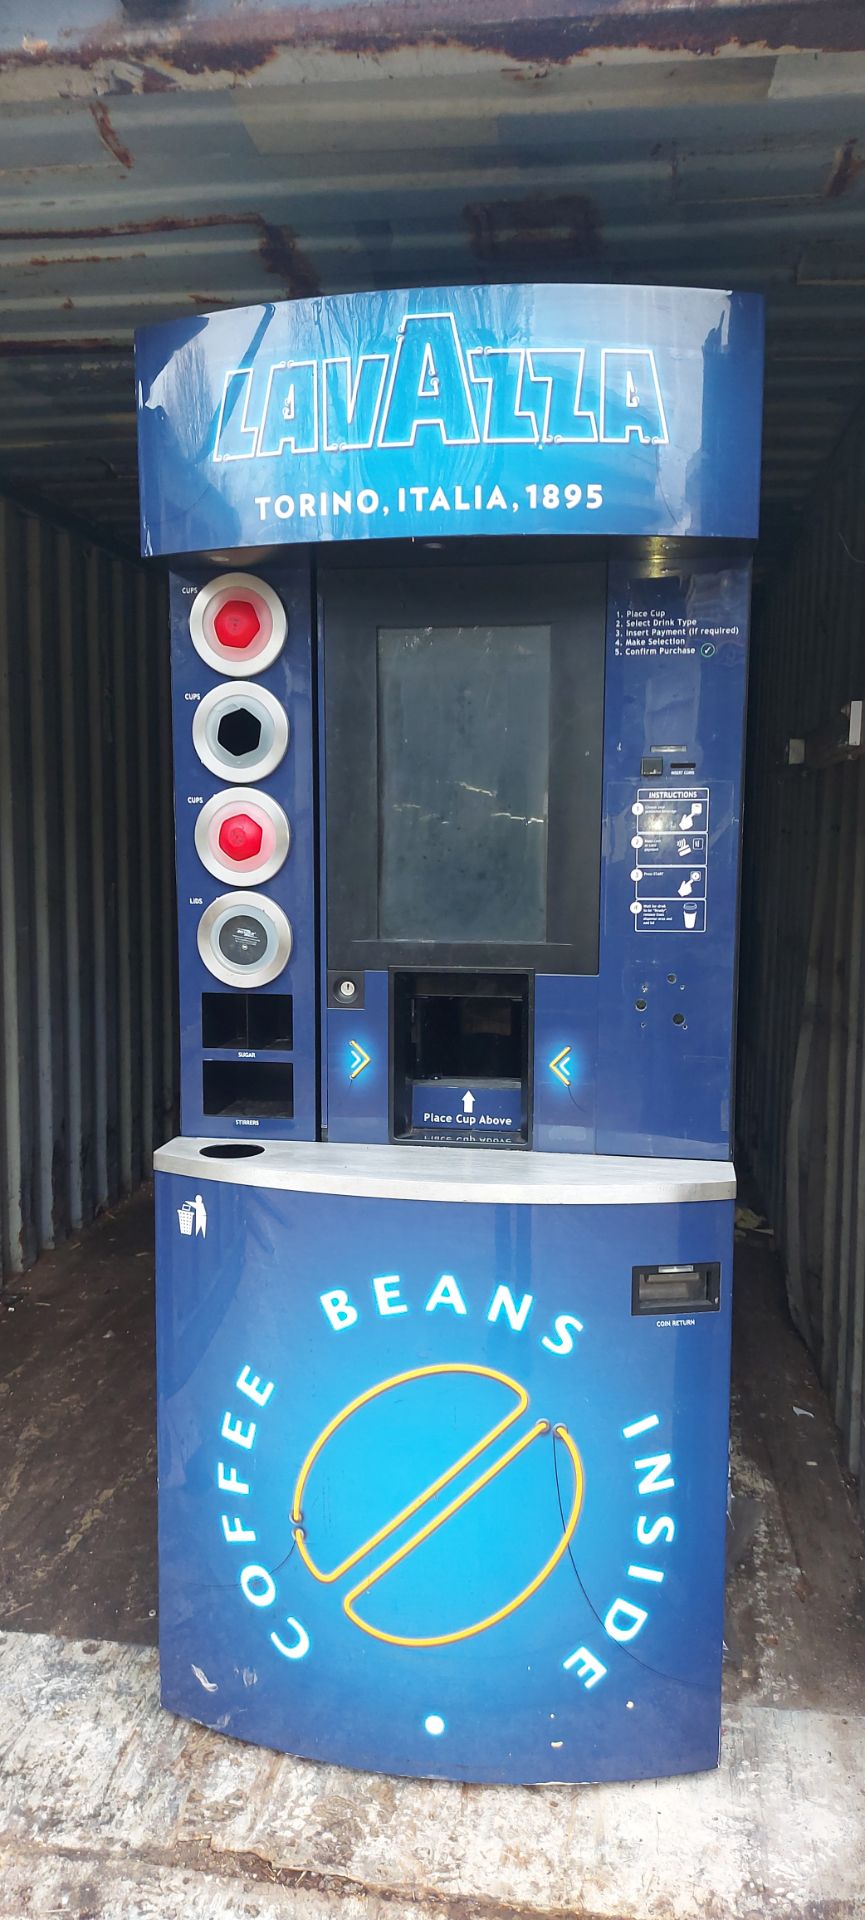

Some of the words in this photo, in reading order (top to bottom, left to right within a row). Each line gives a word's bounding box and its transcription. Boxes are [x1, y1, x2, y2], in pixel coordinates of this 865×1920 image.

[212, 312, 670, 463] LAVAZZA
[255, 488, 389, 521] TORINO,
[398, 486, 520, 514] ITALIA,
[526, 484, 603, 510] 1895
[181, 586, 198, 594] CUPS
[650, 609, 666, 619] Cup
[615, 620, 623, 628] 2.
[625, 619, 651, 627] Select
[677, 618, 697, 627] Type
[615, 629, 623, 637] 3.
[625, 629, 649, 637] Insert
[651, 628, 686, 637] Payment
[700, 626, 739, 636] required)
[625, 638, 646, 646] Make
[648, 637, 685, 645] Selection
[614, 648, 623, 656] 5.
[625, 647, 657, 656] Confirm
[659, 647, 696, 655] Purchase
[184, 692, 201, 700] CUPS
[187, 796, 204, 804] CUPS
[648, 791, 697, 799] INSTRUCTIONS
[189, 897, 203, 905] LIDS
[423, 1112, 453, 1123] Place
[455, 1114, 476, 1125] Cup
[478, 1115, 512, 1125] Above
[320, 1274, 584, 1356] BEANS
[656, 1320, 671, 1328] COIN
[672, 1319, 696, 1327] RETURN
[217, 1365, 311, 1660] COFFEE
[562, 1414, 676, 1690] INSIDE
